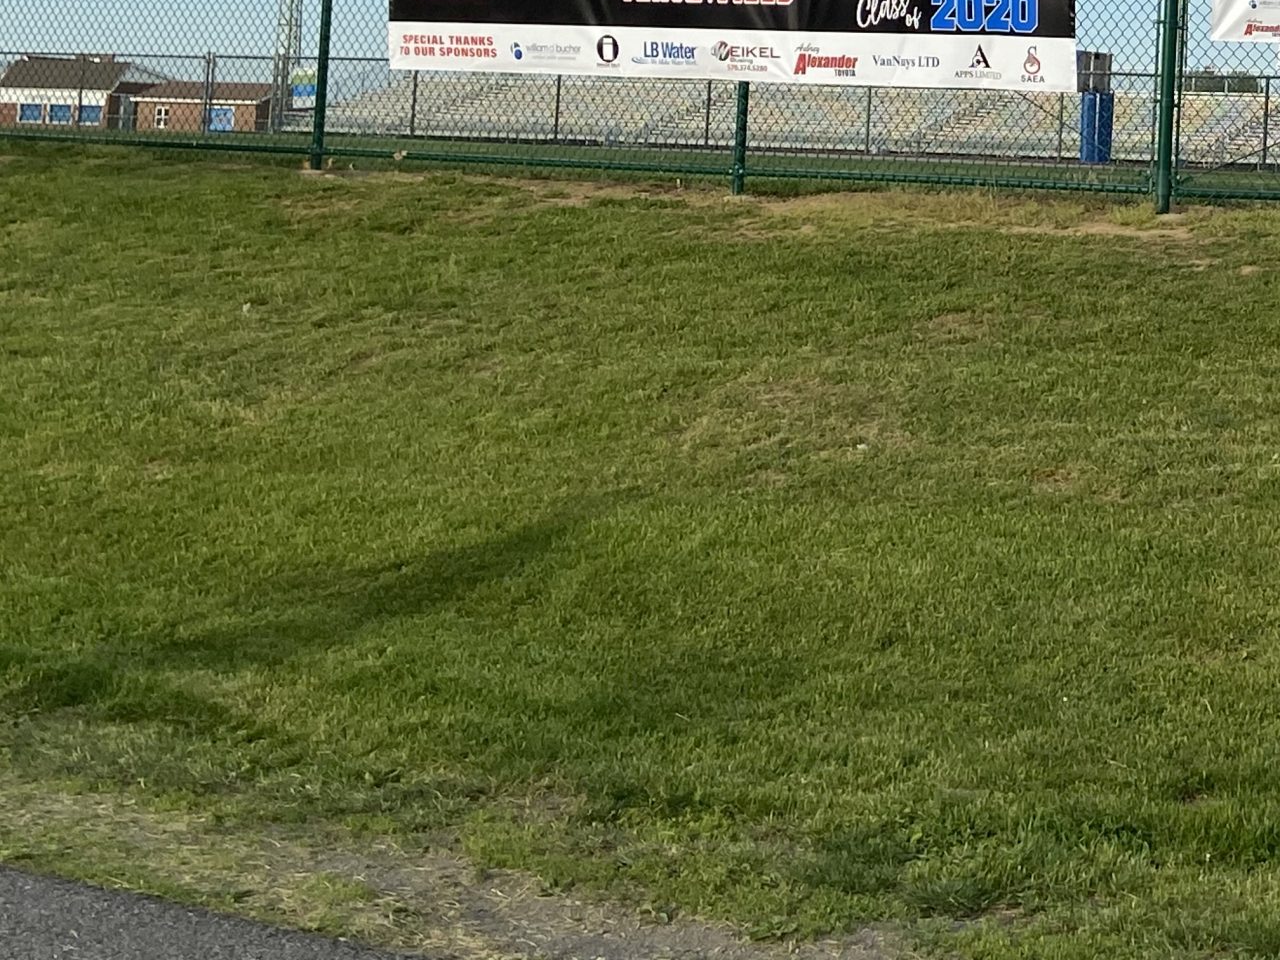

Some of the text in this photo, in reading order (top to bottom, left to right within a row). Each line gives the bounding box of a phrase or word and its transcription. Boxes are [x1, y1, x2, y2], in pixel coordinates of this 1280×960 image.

[905, 4, 922, 30] of
[402, 34, 493, 47] SPECIAL THANKS
[400, 45, 497, 58] TO OUR SPONSORS
[644, 41, 697, 59] LB Water
[794, 53, 858, 75] Alexander
[872, 55, 940, 70] VanNuys LTD
[834, 69, 856, 77] TOYOTA
[1021, 74, 1045, 83] SAEA
